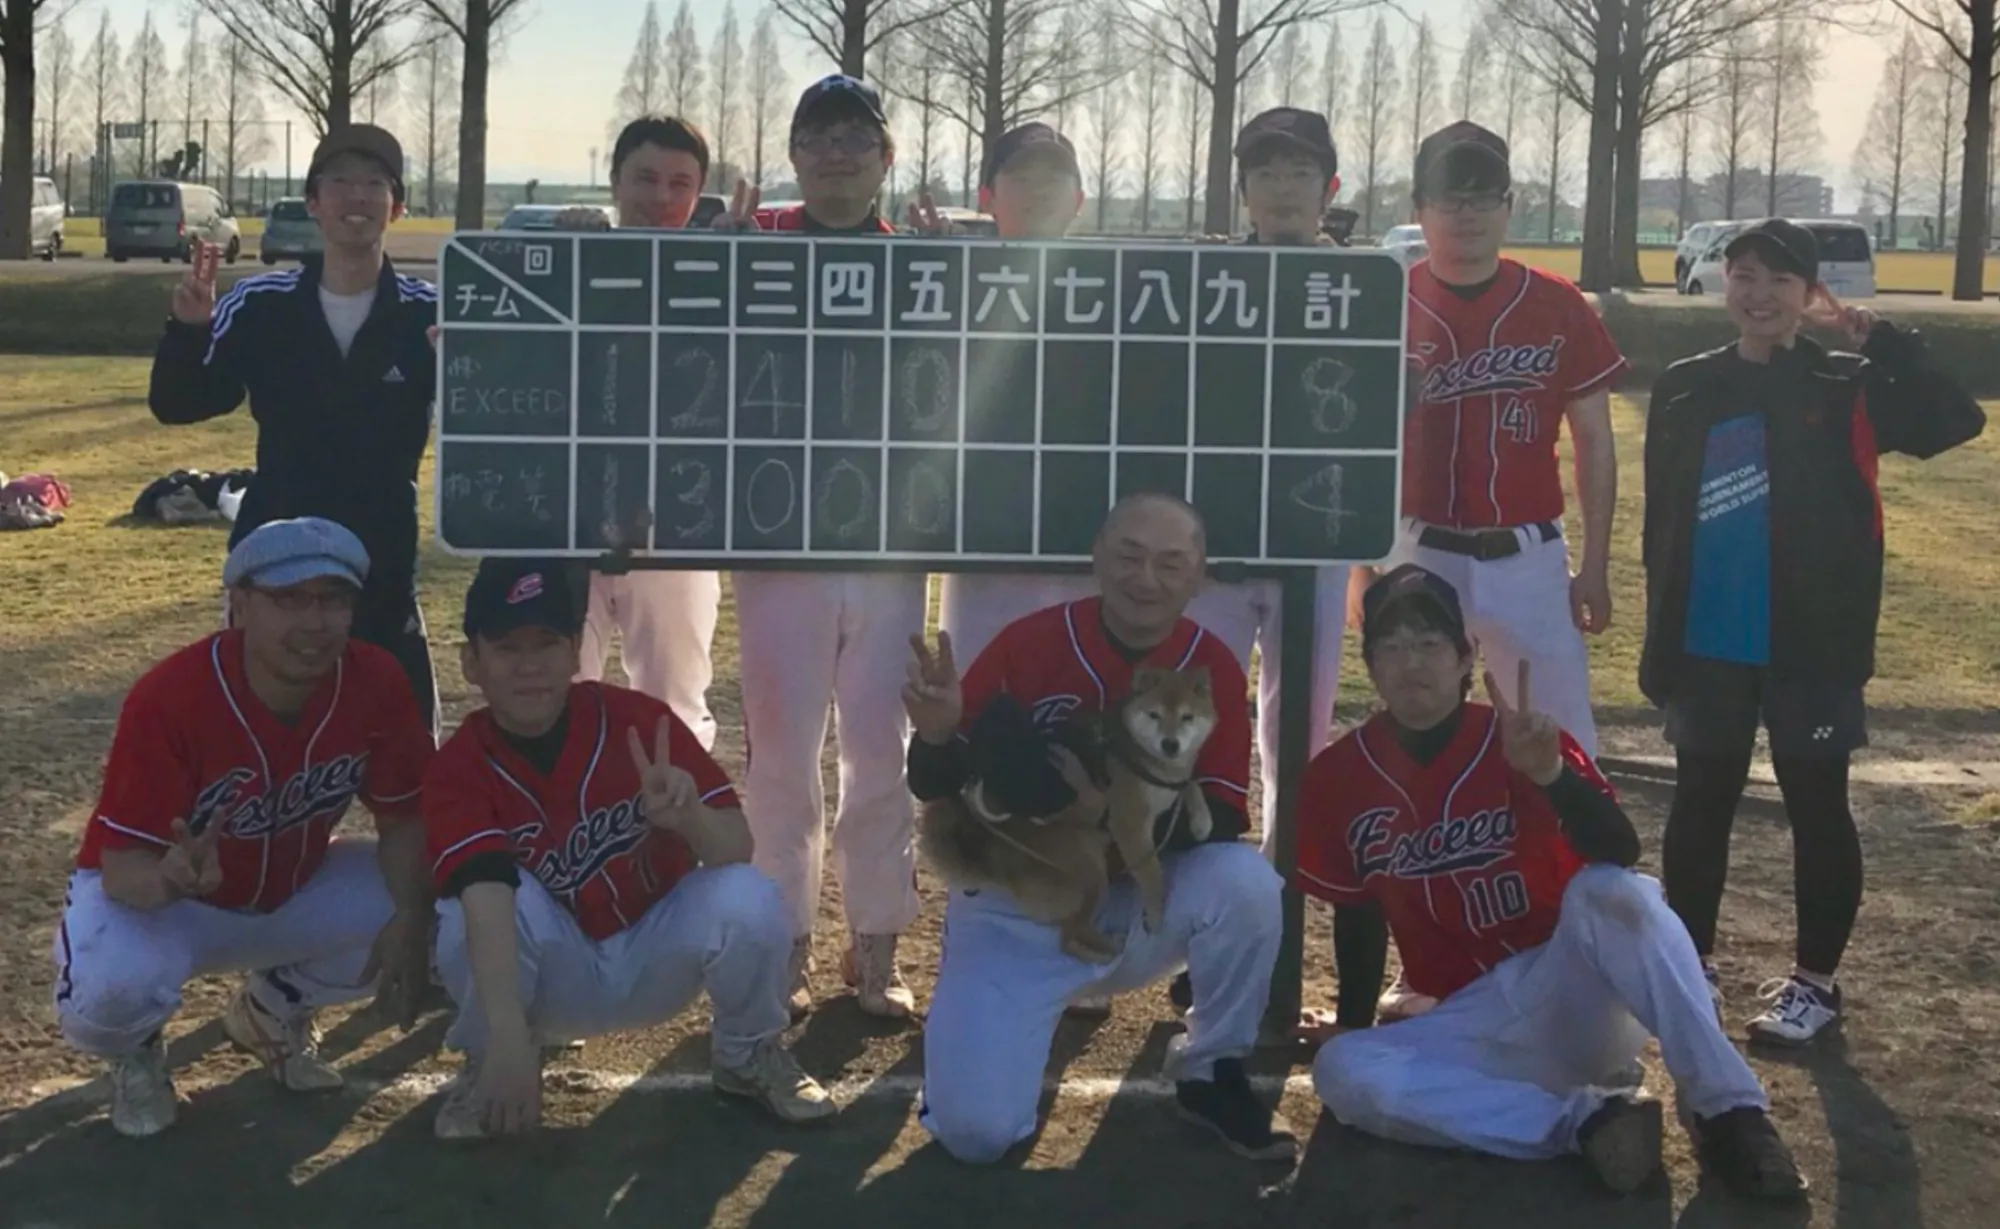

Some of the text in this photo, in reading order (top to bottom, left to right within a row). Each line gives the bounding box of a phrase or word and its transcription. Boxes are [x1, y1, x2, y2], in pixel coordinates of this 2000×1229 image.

[524, 245, 552, 275] 回
[455, 284, 521, 318] チーム
[668, 260, 722, 308] 二
[745, 260, 798, 315] 三
[822, 262, 875, 316] 四
[901, 261, 952, 322] 五
[974, 265, 1031, 324] 六
[1053, 266, 1106, 324] 七
[1129, 268, 1181, 325] 八
[1205, 268, 1259, 328] 九
[1303, 271, 1361, 331] 計
[450, 343, 1357, 436] EXCEED 1 2 4 1 0 8
[1500, 396, 1539, 445] 41
[603, 451, 620, 534] 1
[668, 459, 715, 538] 3
[746, 457, 796, 535] 0
[817, 457, 874, 538] 0
[902, 460, 950, 535] 0
[1289, 462, 1358, 545] 4
[1346, 806, 1519, 882] Exceed
[1468, 870, 1530, 928] 10
